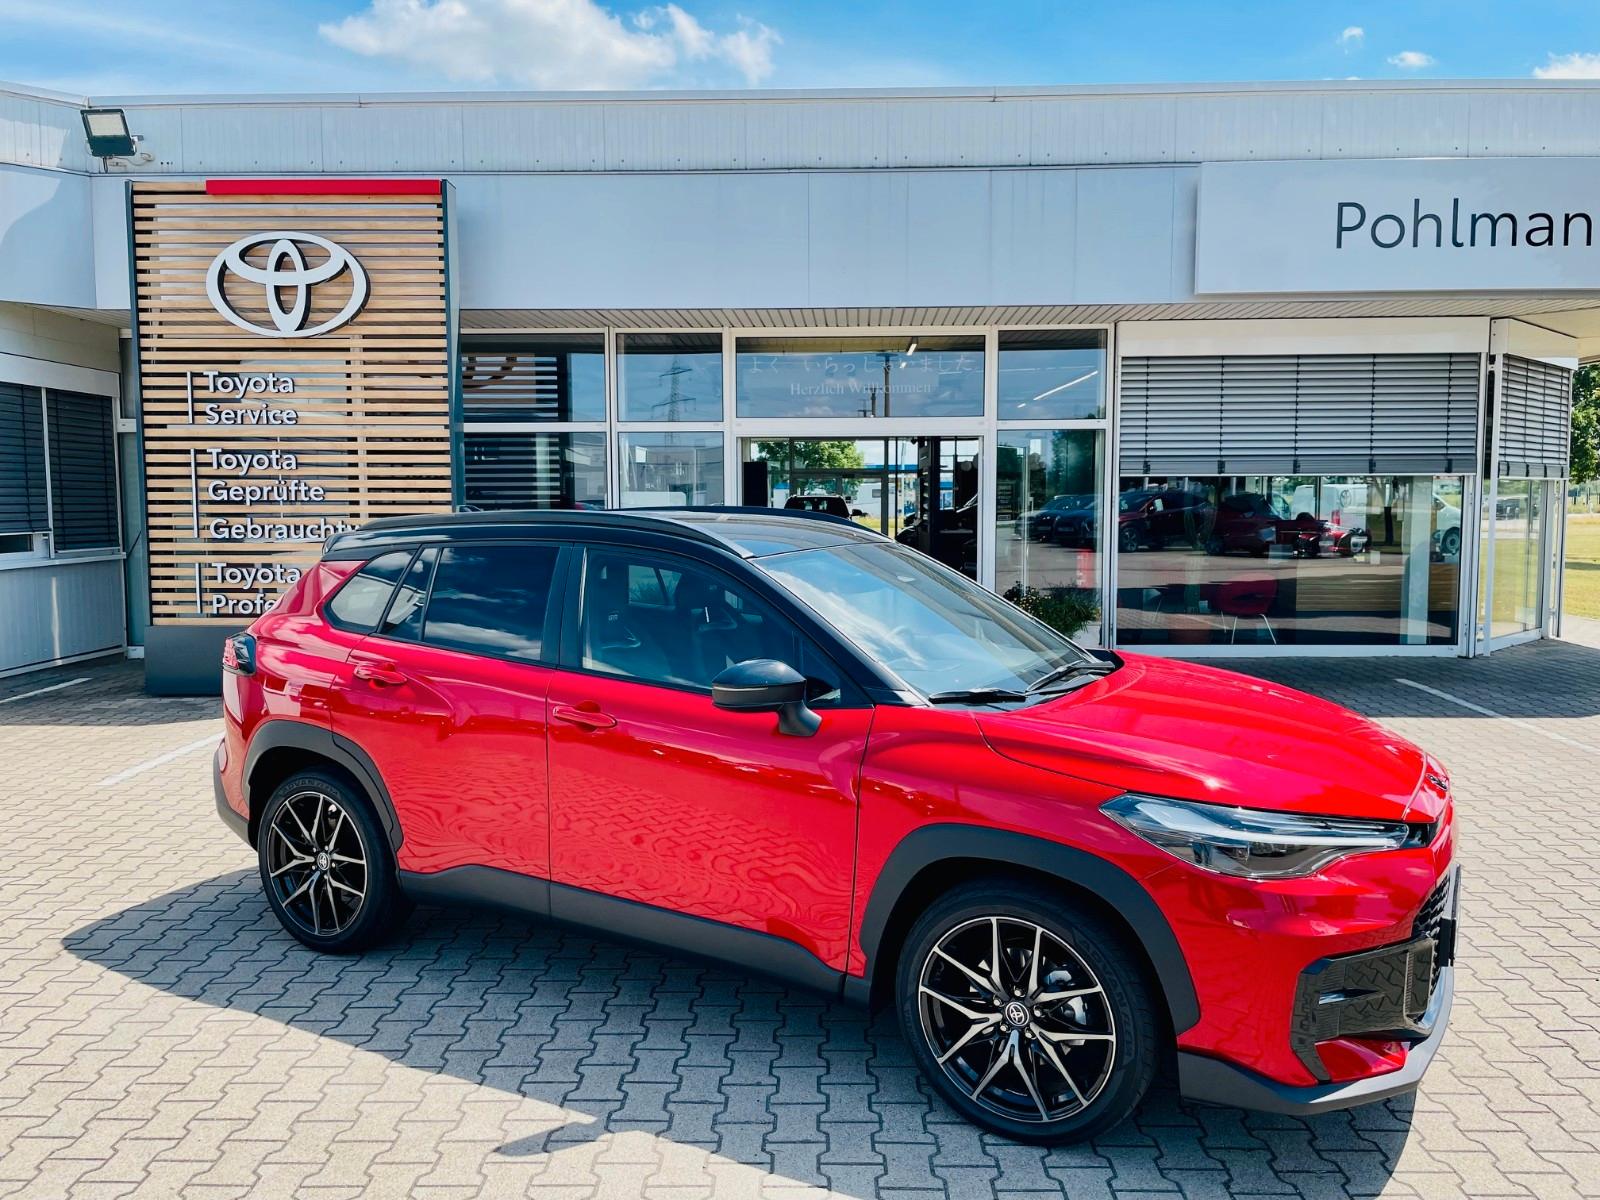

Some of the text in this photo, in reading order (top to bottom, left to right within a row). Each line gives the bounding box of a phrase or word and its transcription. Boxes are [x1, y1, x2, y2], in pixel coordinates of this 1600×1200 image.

[1336, 197, 1593, 249] Pohlman
[203, 371, 295, 399] Toyota
[790, 382, 845, 396] Herzlich
[204, 403, 298, 425] Service
[206, 448, 297, 475] Toyota
[208, 479, 325, 505] Geprüfte
[212, 562, 300, 589] Toyota
